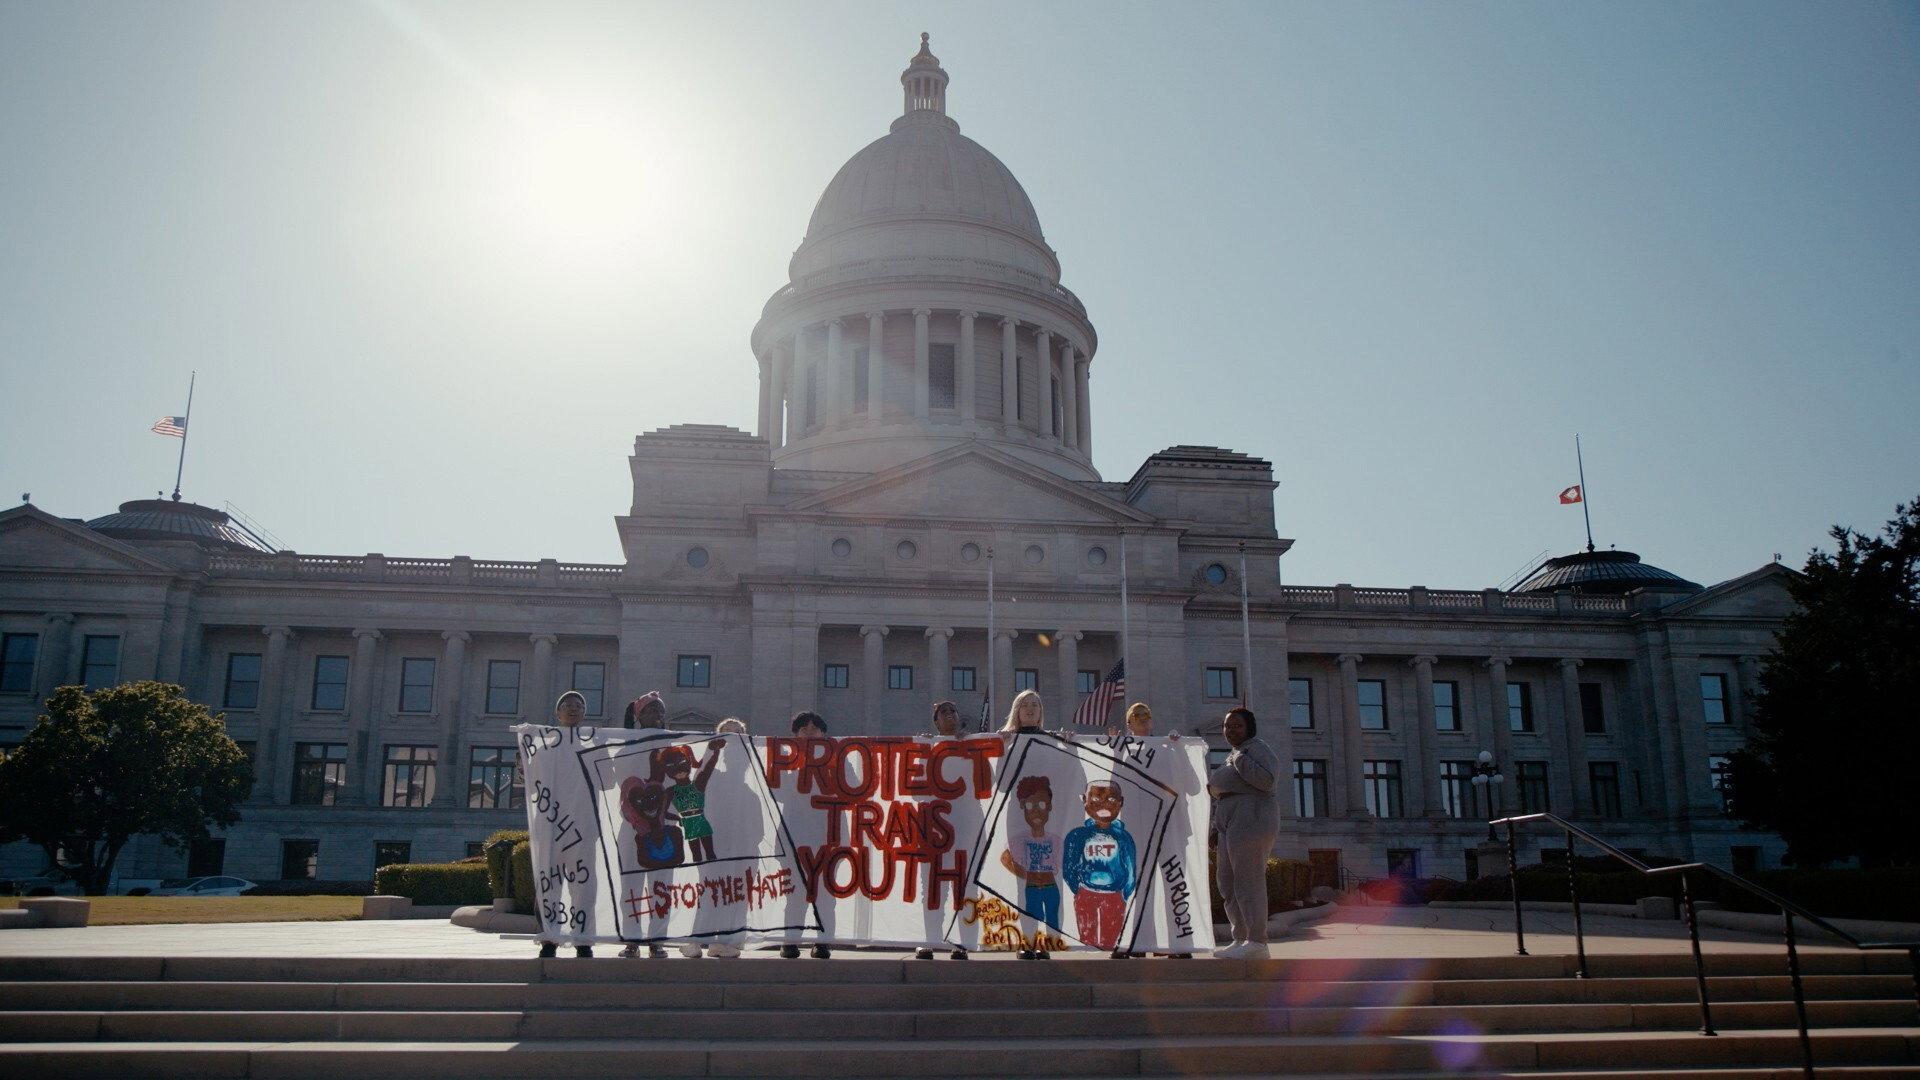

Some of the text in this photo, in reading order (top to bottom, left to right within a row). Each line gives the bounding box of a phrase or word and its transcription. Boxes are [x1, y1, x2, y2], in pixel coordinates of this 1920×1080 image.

[766, 736, 1004, 800] PROTECT
[531, 780, 582, 852] SB347
[811, 795, 955, 853] TRANS
[797, 845, 967, 910] YOUTH
[1161, 854, 1194, 939] HJR1024
